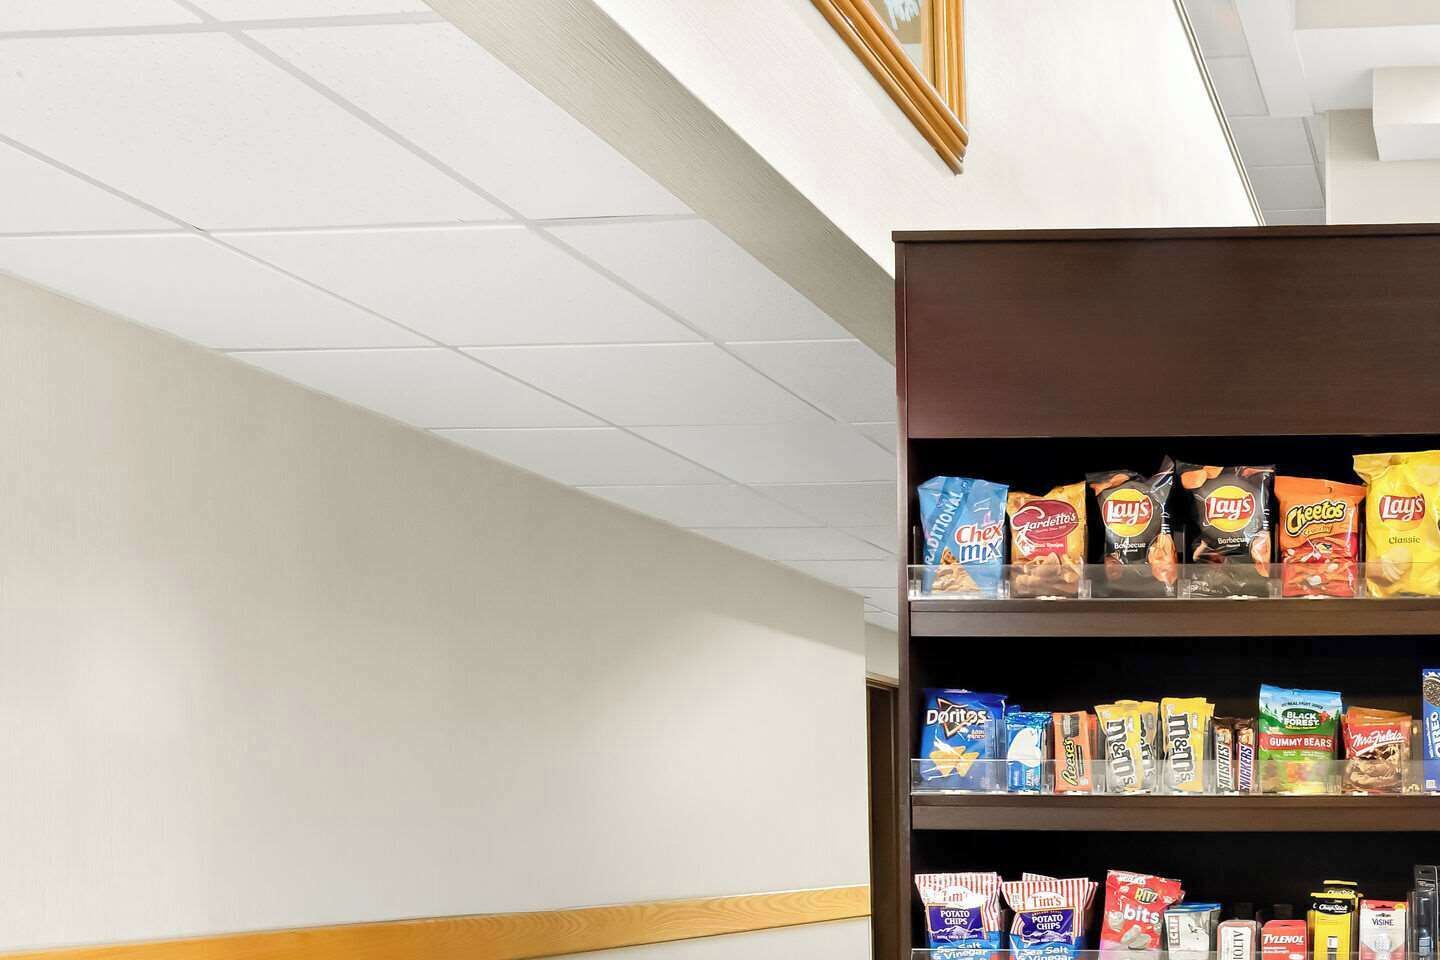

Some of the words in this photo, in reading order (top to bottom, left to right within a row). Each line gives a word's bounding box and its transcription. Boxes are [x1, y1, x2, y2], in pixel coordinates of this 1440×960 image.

[1106, 499, 1149, 525] Lay's
[1208, 497, 1251, 520] Lay's
[1382, 496, 1423, 521] Lay's
[1010, 506, 1076, 538] Gardetto's
[1286, 501, 1346, 536] Cheetos
[924, 490, 964, 566] RADITIONAL
[955, 522, 1003, 545] Chex
[1388, 536, 1421, 545] Classic
[926, 709, 987, 725] Doritos
[1284, 719, 1320, 727] FOREST
[1286, 711, 1317, 720] BLACK
[1269, 737, 1302, 747] GUMMY
[1303, 738, 1333, 748] BEARS
[1061, 736, 1079, 786] Reese's
[1134, 887, 1158, 902] RITZ
[940, 910, 970, 918] POTATO
[1031, 914, 1064, 923] POTATO
[1123, 904, 1160, 924] bits
[1036, 922, 1061, 930] CHIPS
[1263, 933, 1305, 945] TYLENOL
[1046, 946, 1069, 954] Salt
